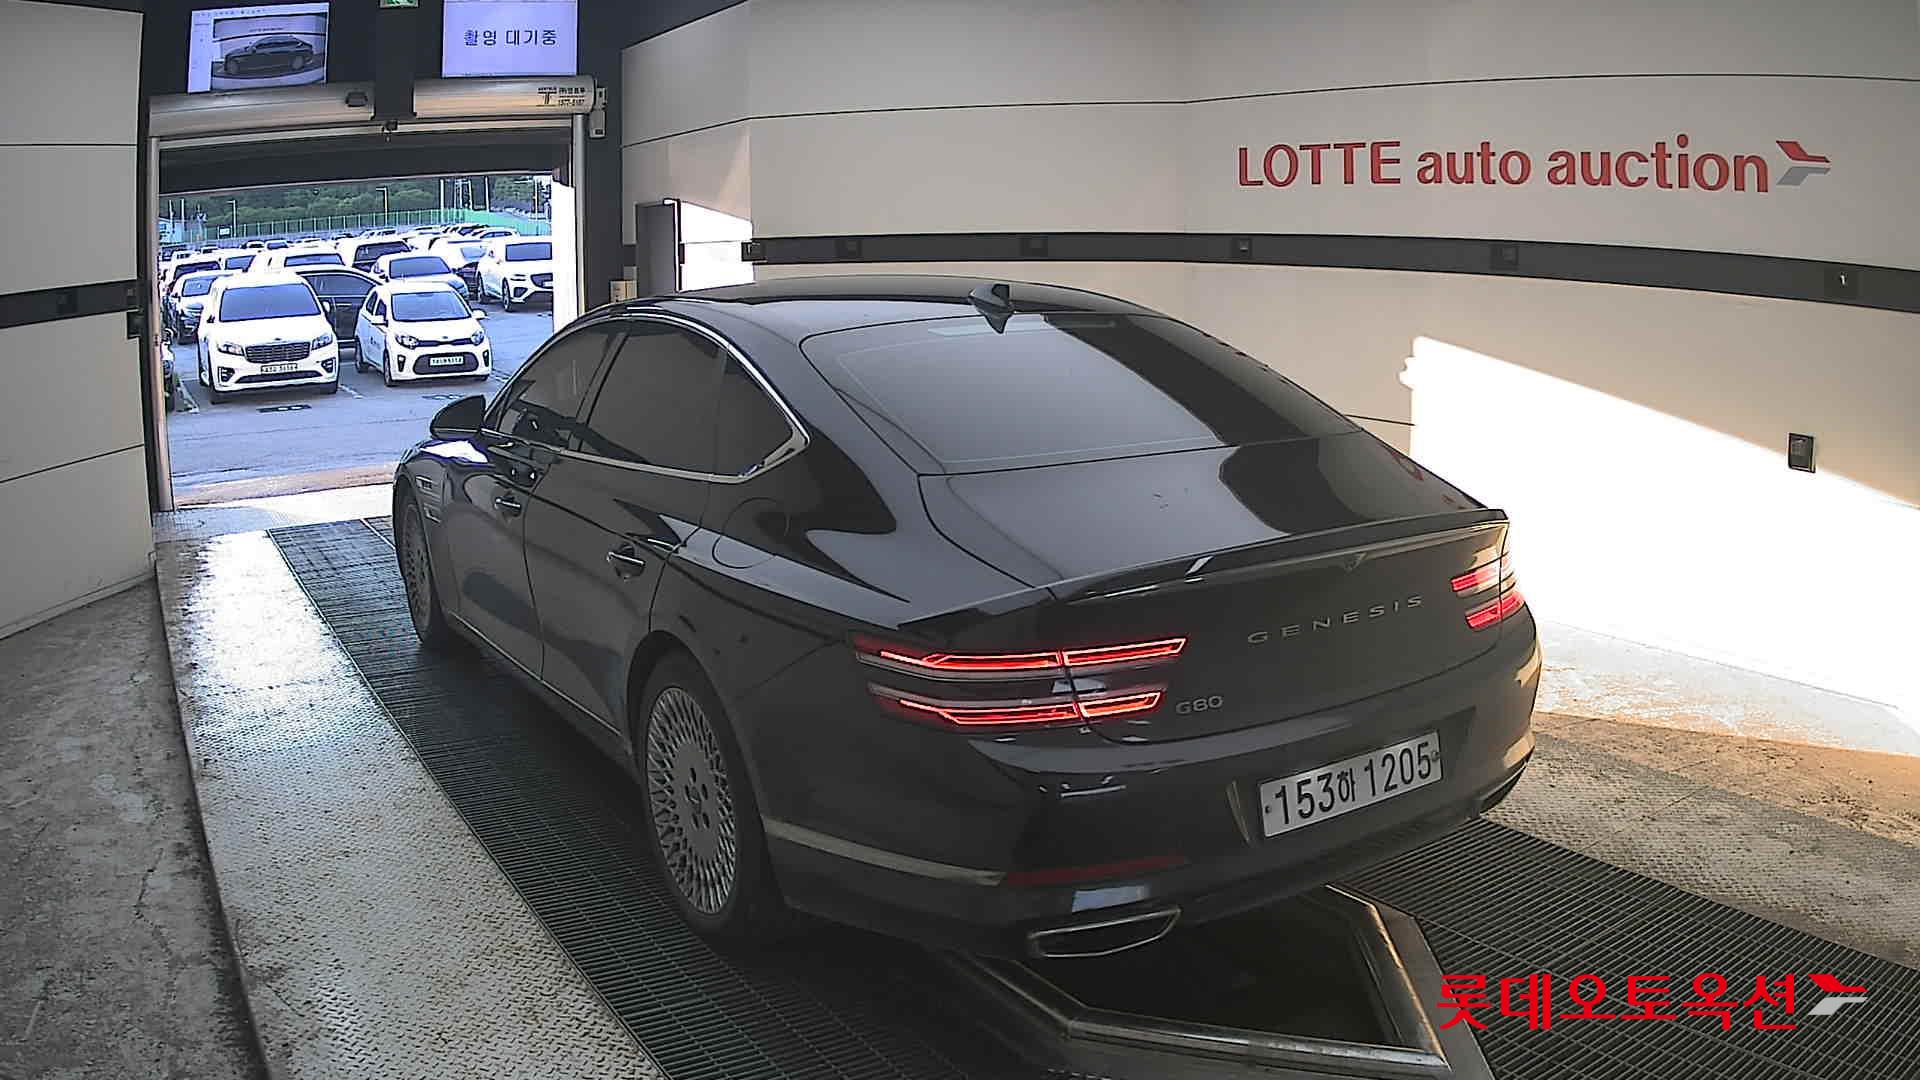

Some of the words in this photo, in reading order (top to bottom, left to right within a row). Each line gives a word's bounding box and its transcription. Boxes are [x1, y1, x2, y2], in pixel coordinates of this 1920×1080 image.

[506, 29, 558, 46] 대기중
[1239, 141, 1400, 188] LOTTE
[1416, 140, 1532, 186] auto
[1547, 134, 1769, 193] auction
[1247, 595, 1423, 645] GENESIS
[1175, 695, 1224, 715] G80
[1275, 767, 1356, 825] 153하
[1364, 741, 1432, 797] 1205
